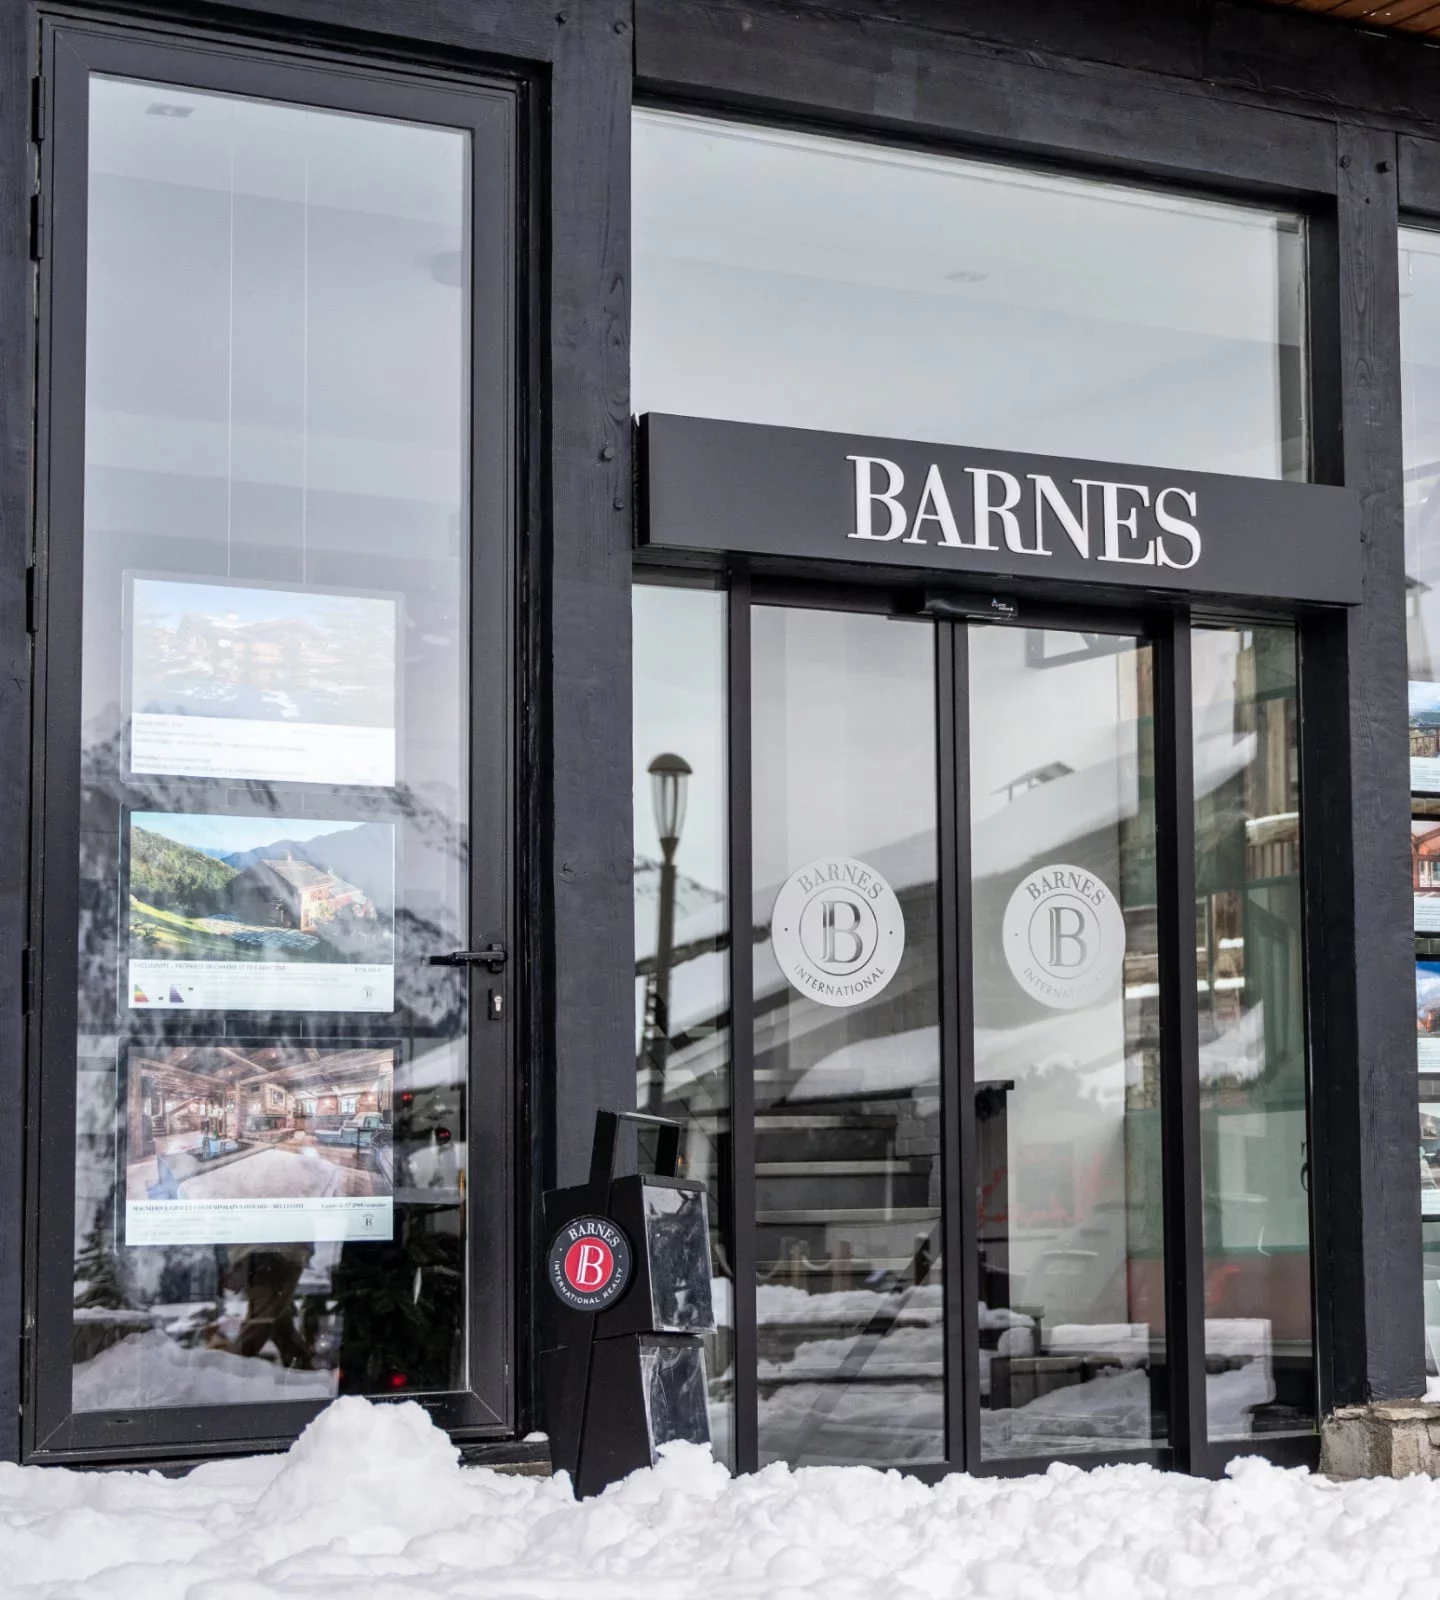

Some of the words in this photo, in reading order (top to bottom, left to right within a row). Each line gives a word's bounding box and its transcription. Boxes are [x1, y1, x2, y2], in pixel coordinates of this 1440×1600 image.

[845, 454, 1202, 570] BARNES
[797, 863, 884, 900] BARNES
[1025, 871, 1106, 906] BARNES
[820, 900, 863, 964] B
[1048, 906, 1087, 968] B
[793, 963, 886, 997] INTERNATIONAL
[568, 1222, 620, 1248] BARNES
[553, 1260, 600, 1304] INTERNATIONAL
[602, 1267, 623, 1299] REALTY
[576, 1244, 604, 1286] B
